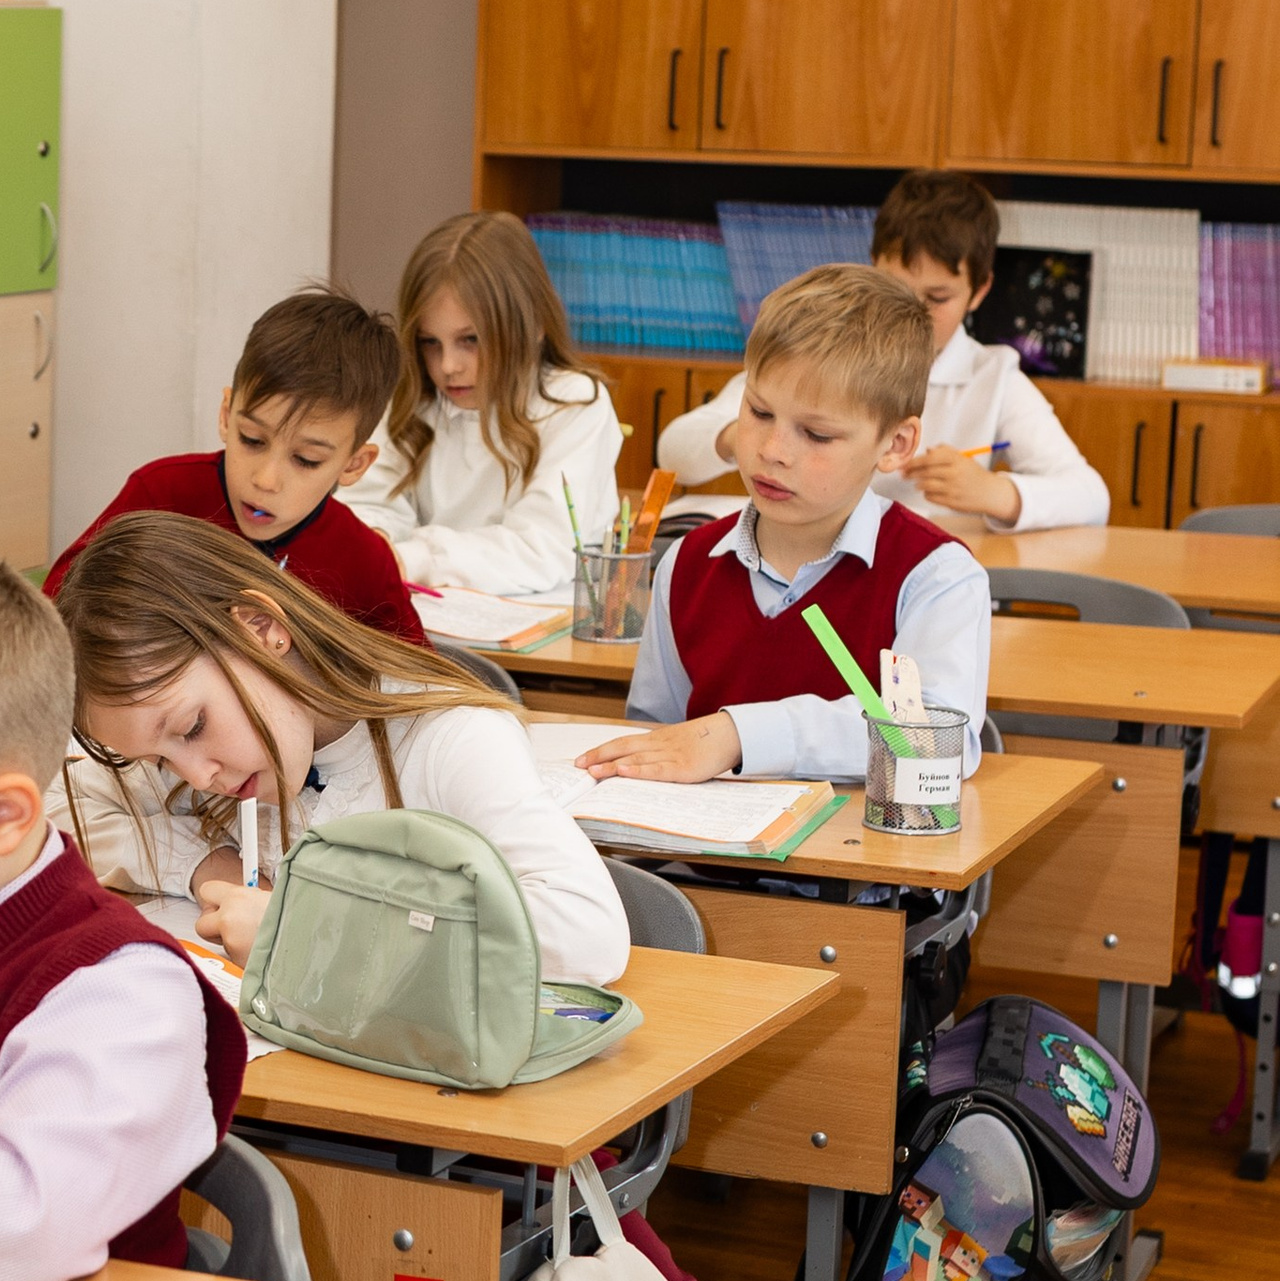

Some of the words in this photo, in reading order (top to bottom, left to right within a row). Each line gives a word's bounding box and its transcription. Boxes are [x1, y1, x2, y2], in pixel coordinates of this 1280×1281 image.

[918, 773, 950, 782] Буйнов
[918, 784, 951, 794] Герман
[1112, 1087, 1142, 1183] MINECRAFT
